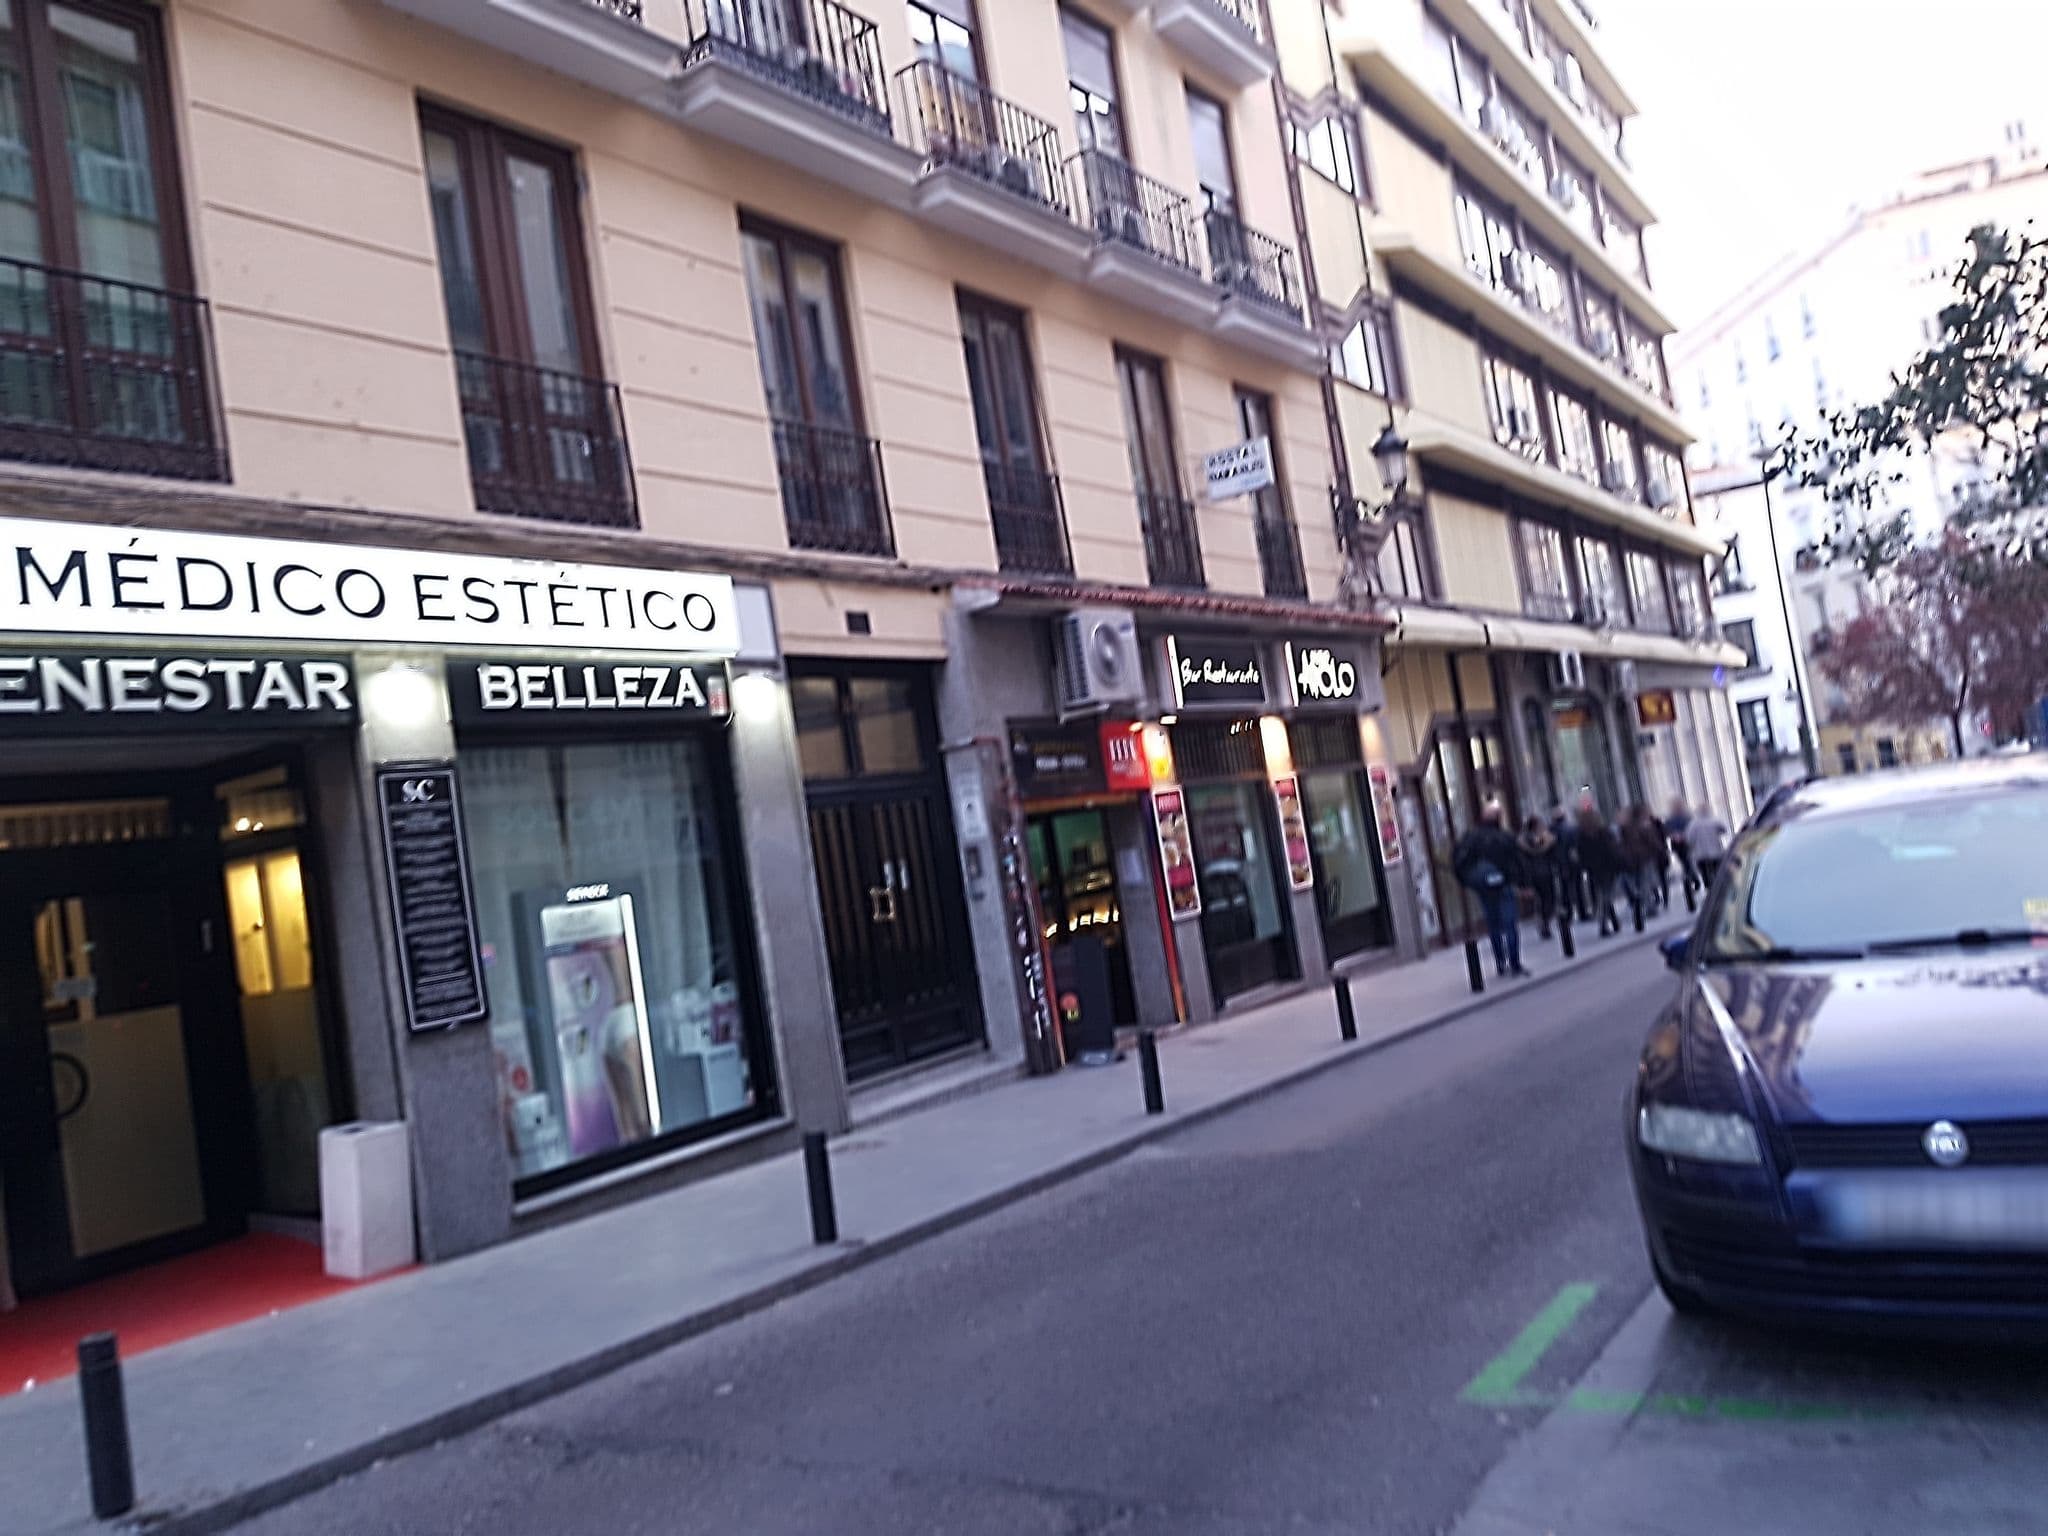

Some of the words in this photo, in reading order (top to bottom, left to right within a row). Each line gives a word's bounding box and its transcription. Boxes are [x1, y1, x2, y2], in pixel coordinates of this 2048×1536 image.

[16, 537, 386, 618] MÉDICO
[413, 571, 716, 632] ESTÉTICO
[476, 664, 707, 711] BELLEZA
